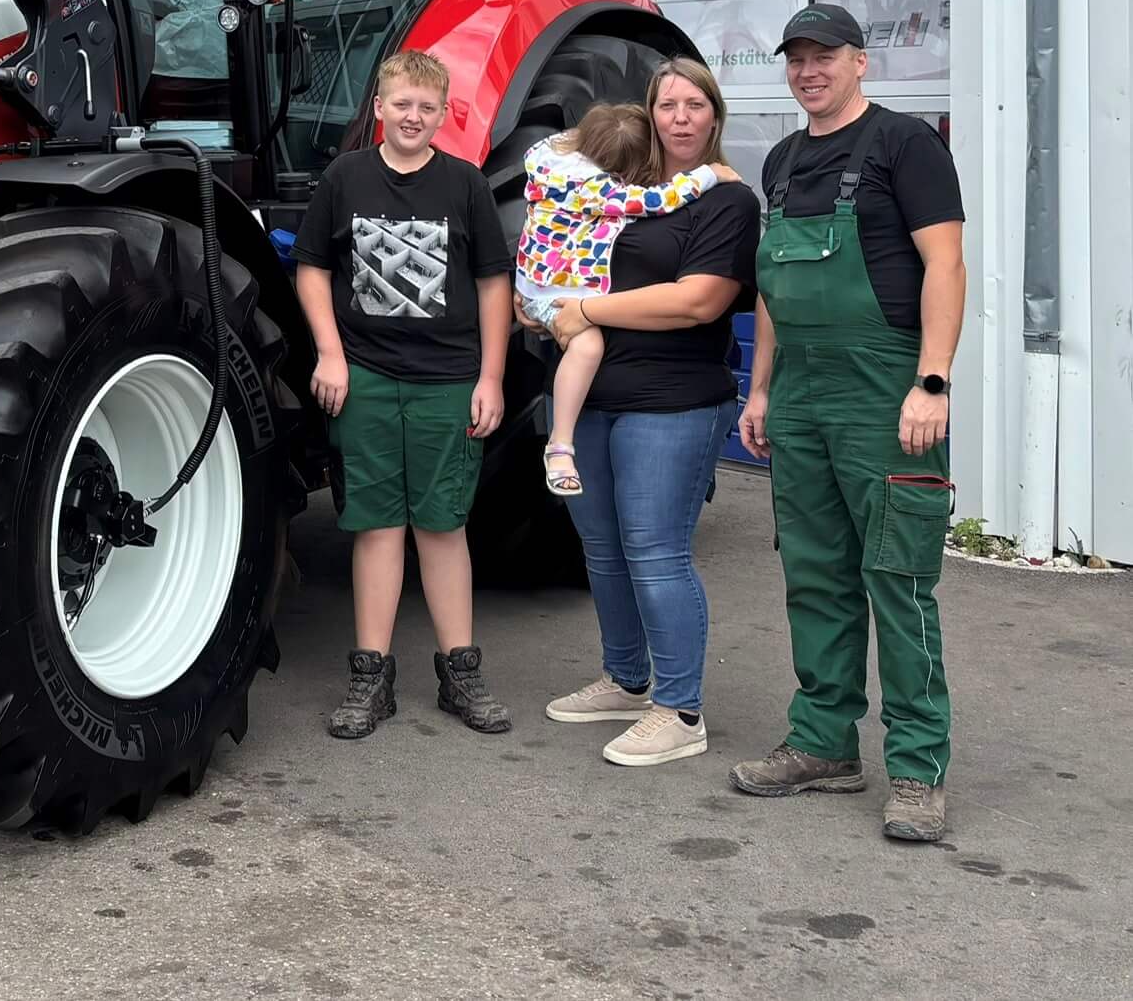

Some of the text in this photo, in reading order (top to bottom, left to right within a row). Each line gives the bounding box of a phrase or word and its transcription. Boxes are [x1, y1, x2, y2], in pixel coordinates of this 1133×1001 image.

[705, 49, 776, 66] erkstätte
[227, 333, 273, 439] CHELIN
[32, 623, 112, 749] MICHELIN
